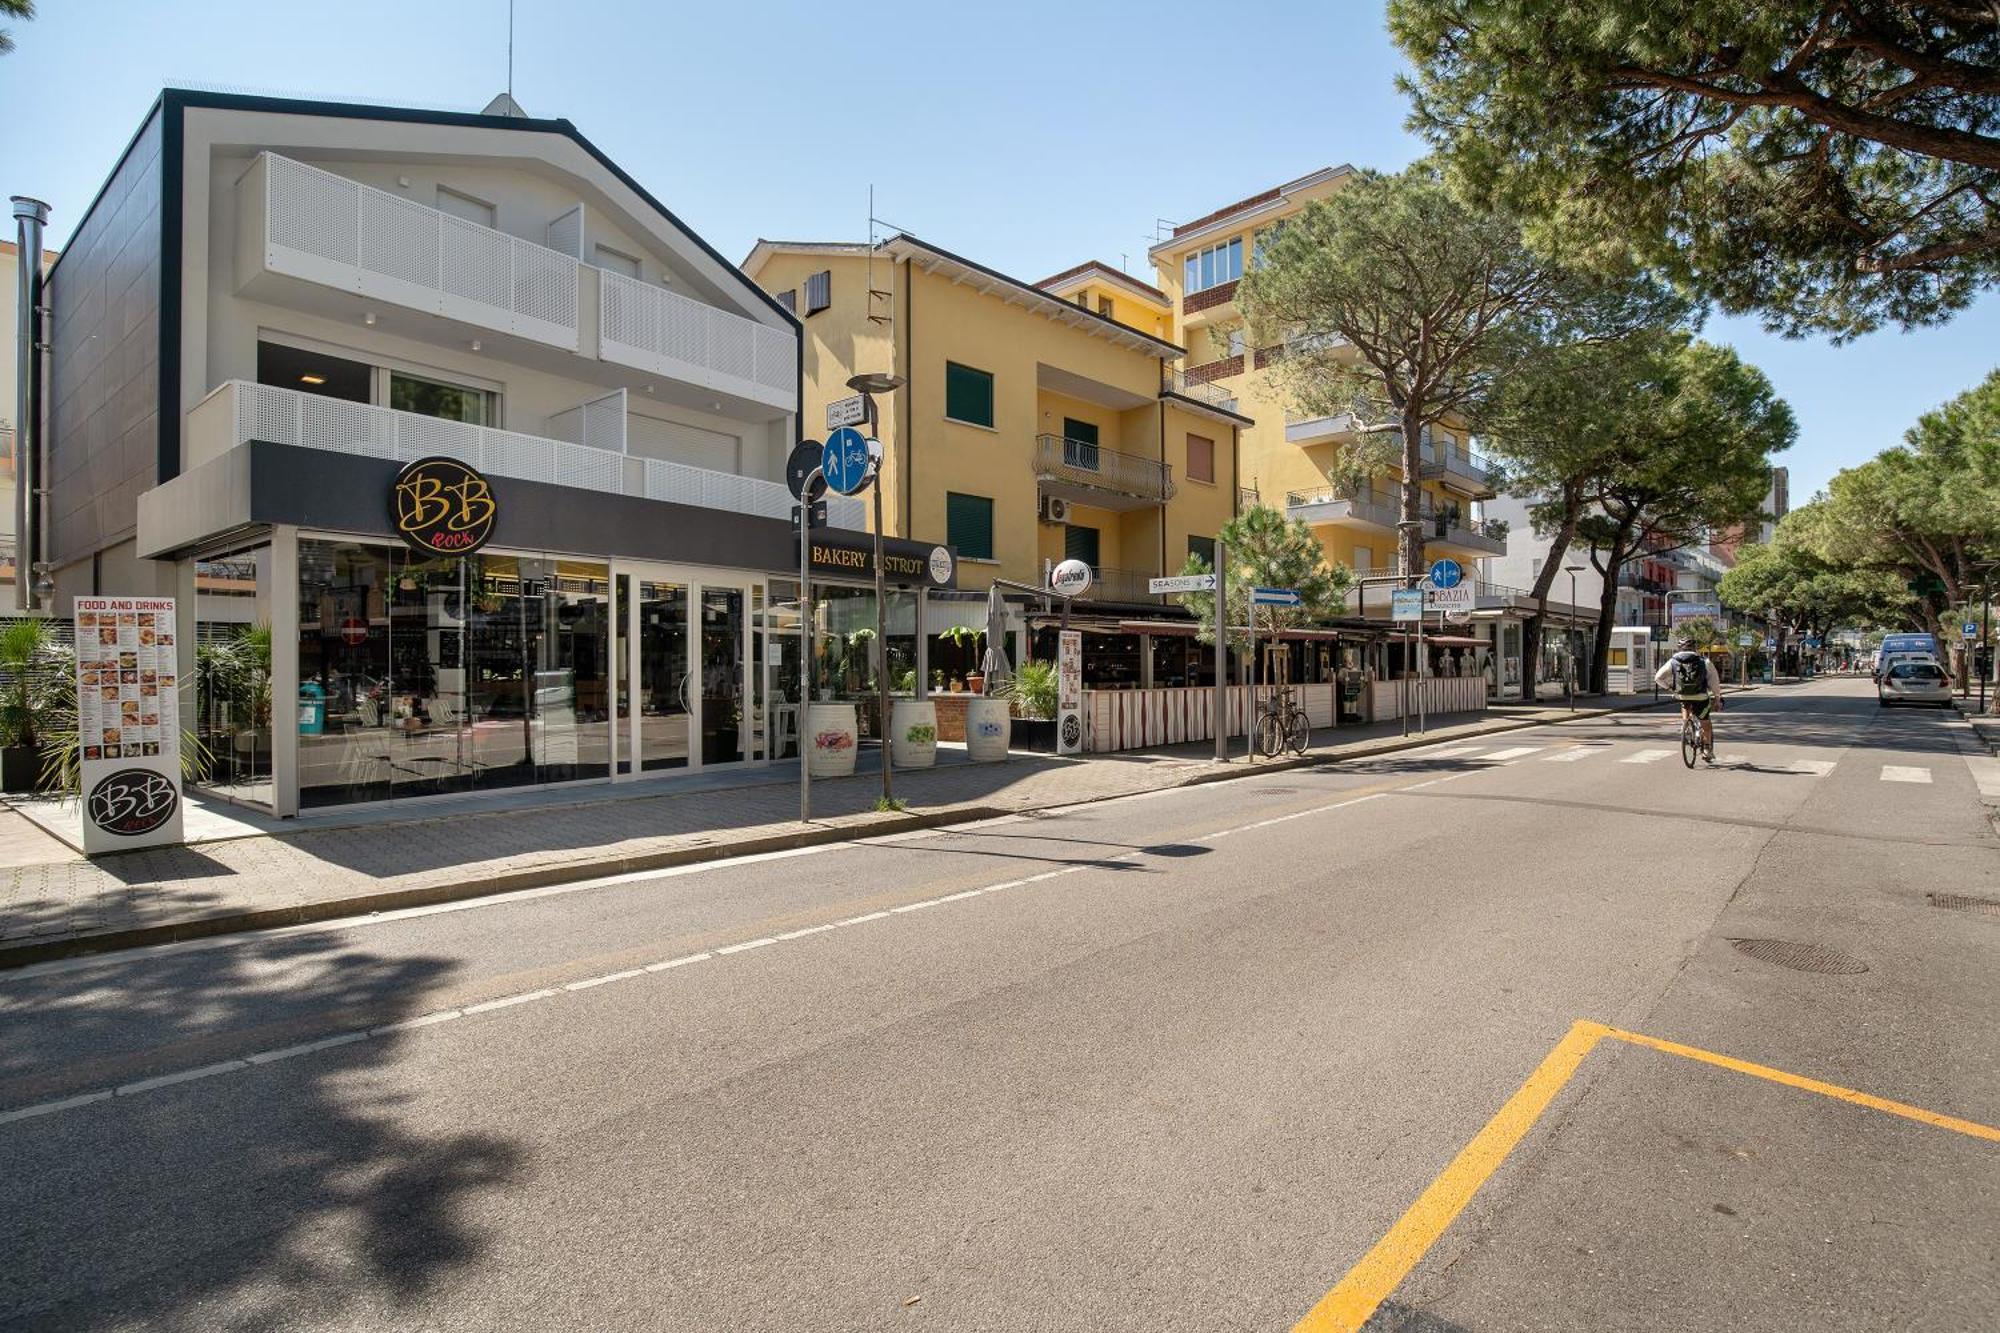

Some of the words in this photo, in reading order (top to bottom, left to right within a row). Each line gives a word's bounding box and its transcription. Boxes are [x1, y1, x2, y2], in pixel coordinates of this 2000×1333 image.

[812, 546, 867, 568] BAKERY
[873, 555, 924, 575] STROT
[1152, 579, 1190, 589] SEASONS
[78, 600, 106, 610] FOOD
[110, 601, 133, 610] AND
[135, 601, 174, 611] DRINKS
[1965, 624, 1975, 633] P
